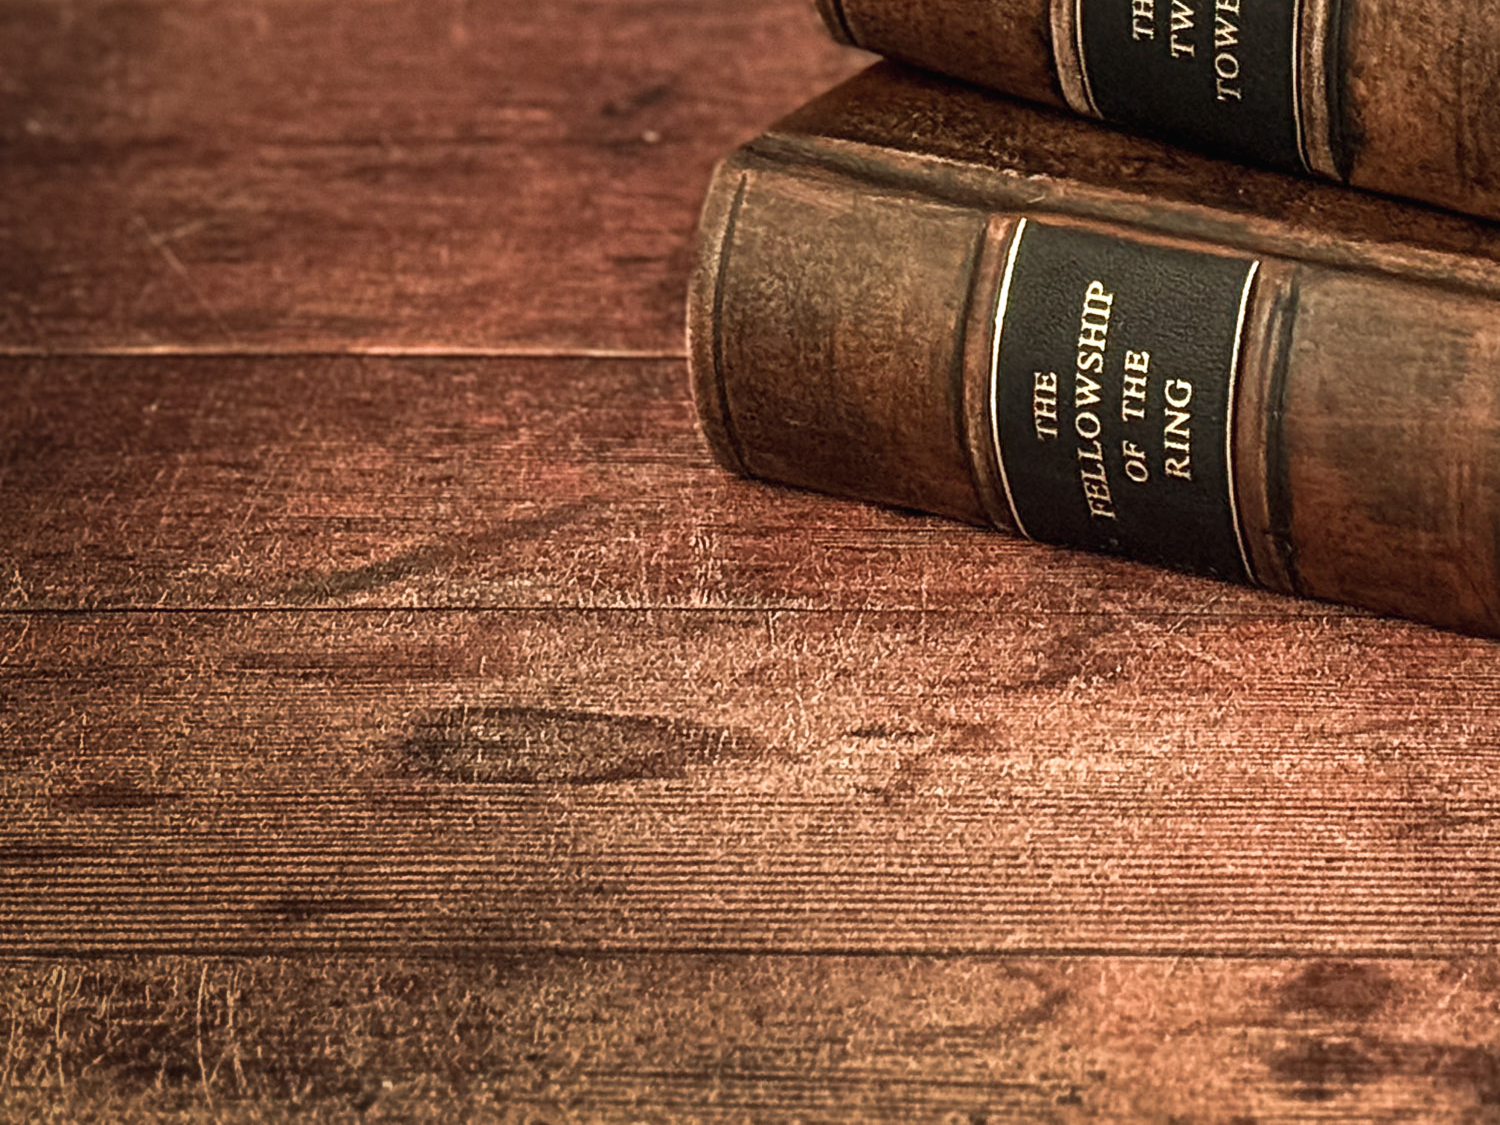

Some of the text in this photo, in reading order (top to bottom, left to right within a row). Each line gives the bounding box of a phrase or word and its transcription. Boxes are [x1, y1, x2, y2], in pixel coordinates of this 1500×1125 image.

[1035, 372, 1057, 440] THE
[1075, 280, 1115, 520] FELLOWSHIP
[1122, 351, 1149, 483] OF THE
[1164, 379, 1192, 480] RING
